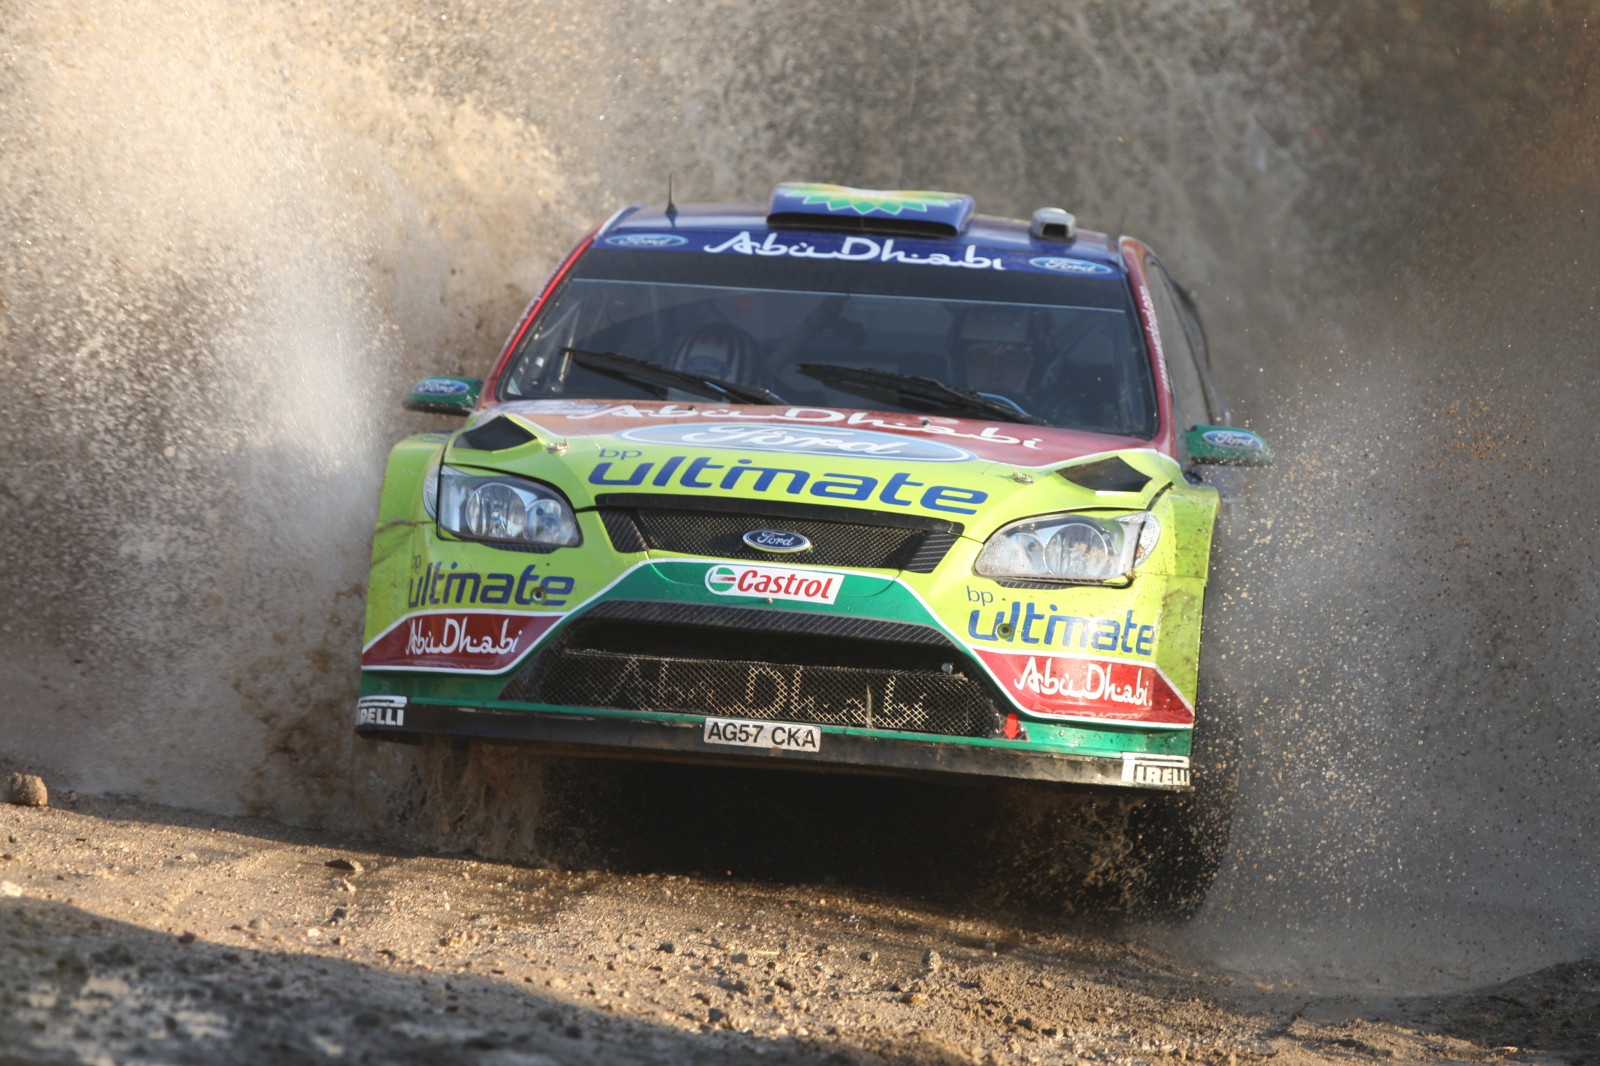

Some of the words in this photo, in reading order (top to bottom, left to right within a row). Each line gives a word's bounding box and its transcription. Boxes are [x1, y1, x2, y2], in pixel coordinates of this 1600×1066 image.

[1044, 259, 1097, 272] Ford
[681, 425, 909, 455] Ford
[1214, 432, 1256, 446] Ford
[599, 449, 642, 461] bp
[588, 456, 989, 515] ultimate
[757, 531, 795, 547] Ford
[408, 562, 575, 608] ultimate
[737, 569, 834, 599] Castrol
[966, 585, 994, 606] bp
[968, 601, 1156, 656] ultimate
[707, 721, 764, 743] AG57
[771, 727, 817, 749] CKA
[1121, 752, 1191, 787] PIRELLI
